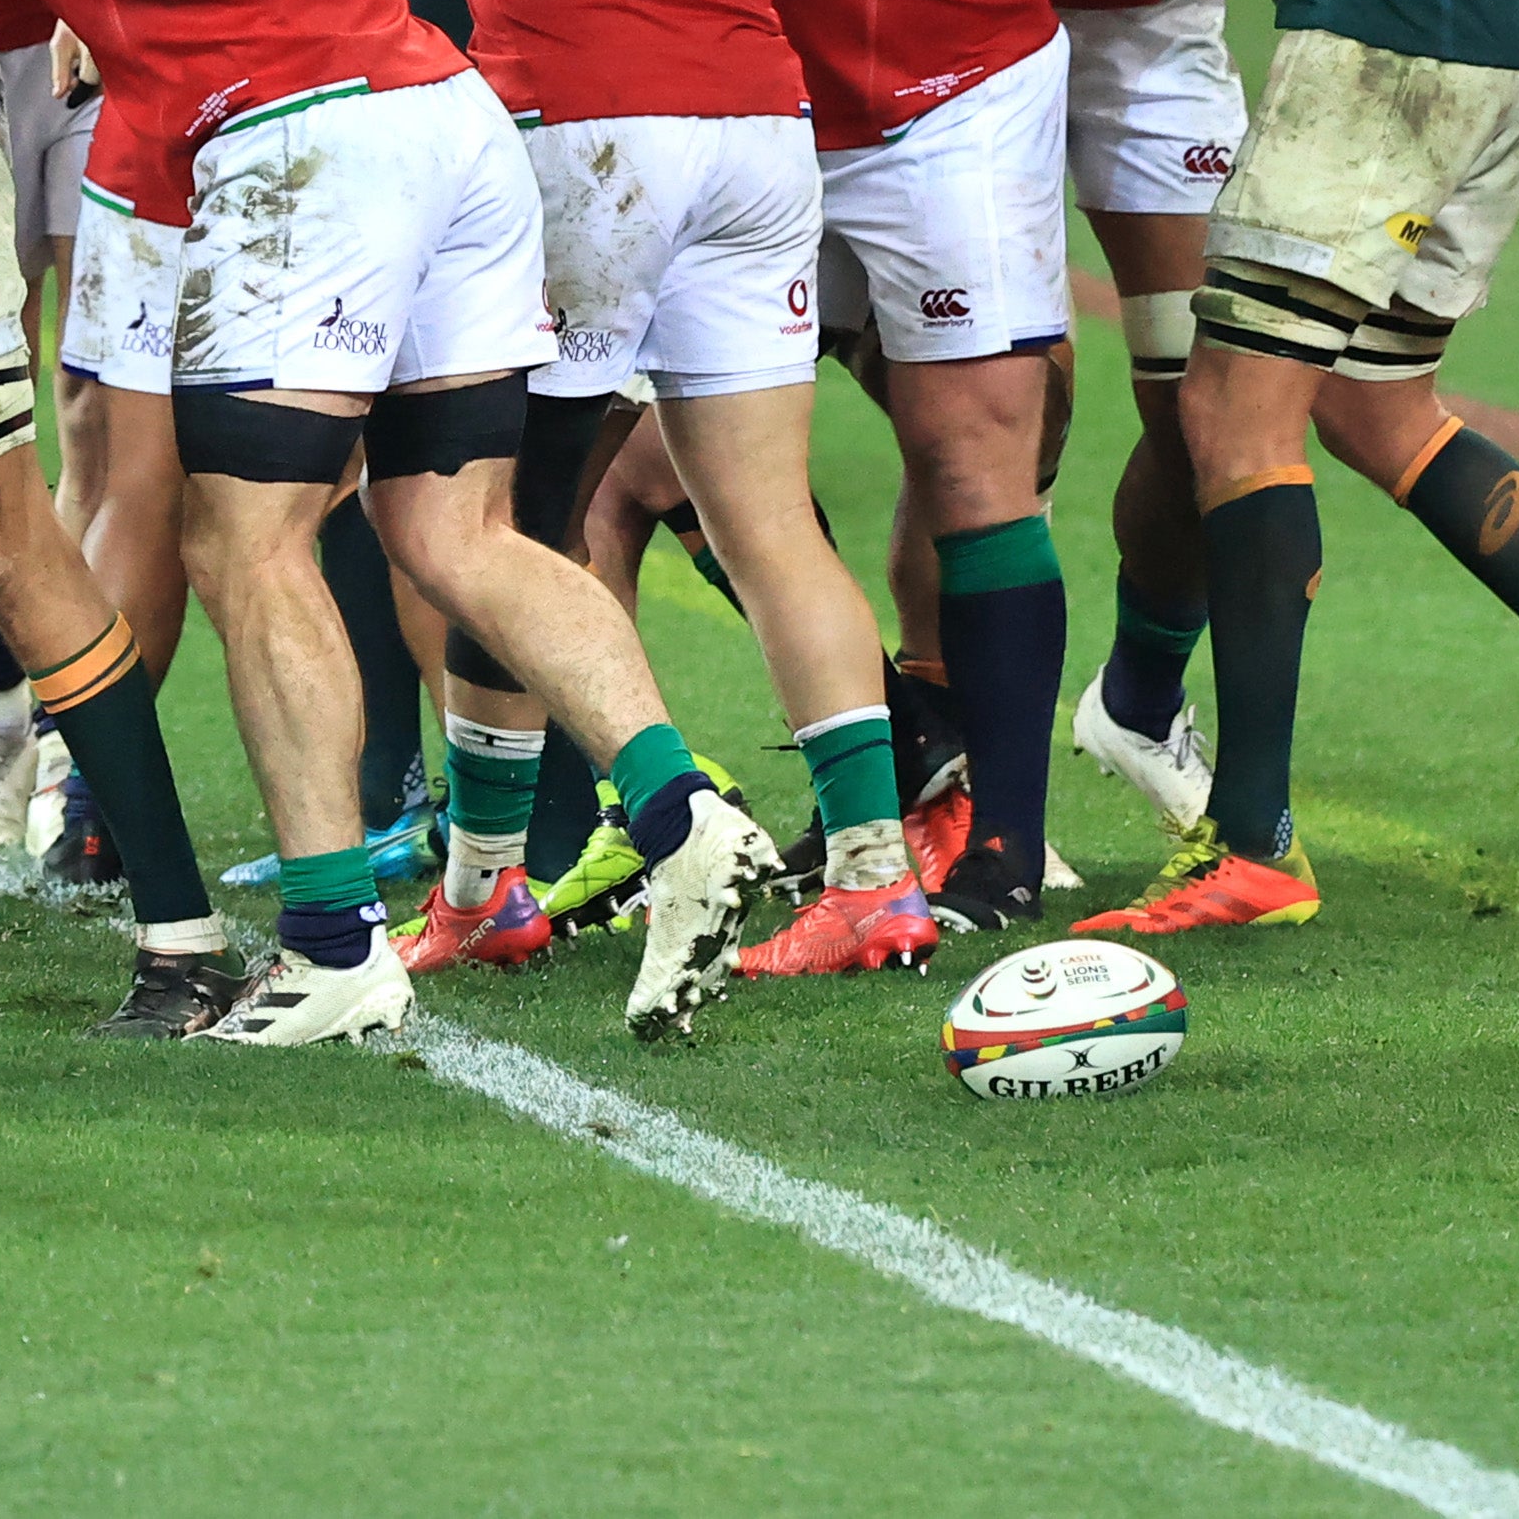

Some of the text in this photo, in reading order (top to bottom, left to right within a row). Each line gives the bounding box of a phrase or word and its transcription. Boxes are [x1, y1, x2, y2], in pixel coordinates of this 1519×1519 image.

[338, 318, 387, 339] ROYAL
[313, 332, 387, 355] LONDON
[562, 330, 613, 347] ROYAL
[560, 345, 613, 362] NDON
[1059, 954, 1104, 965] CASTLE
[1064, 965, 1109, 977] LIONS
[1066, 974, 1111, 986] SERIES
[988, 1043, 1168, 1099] GILBERT
